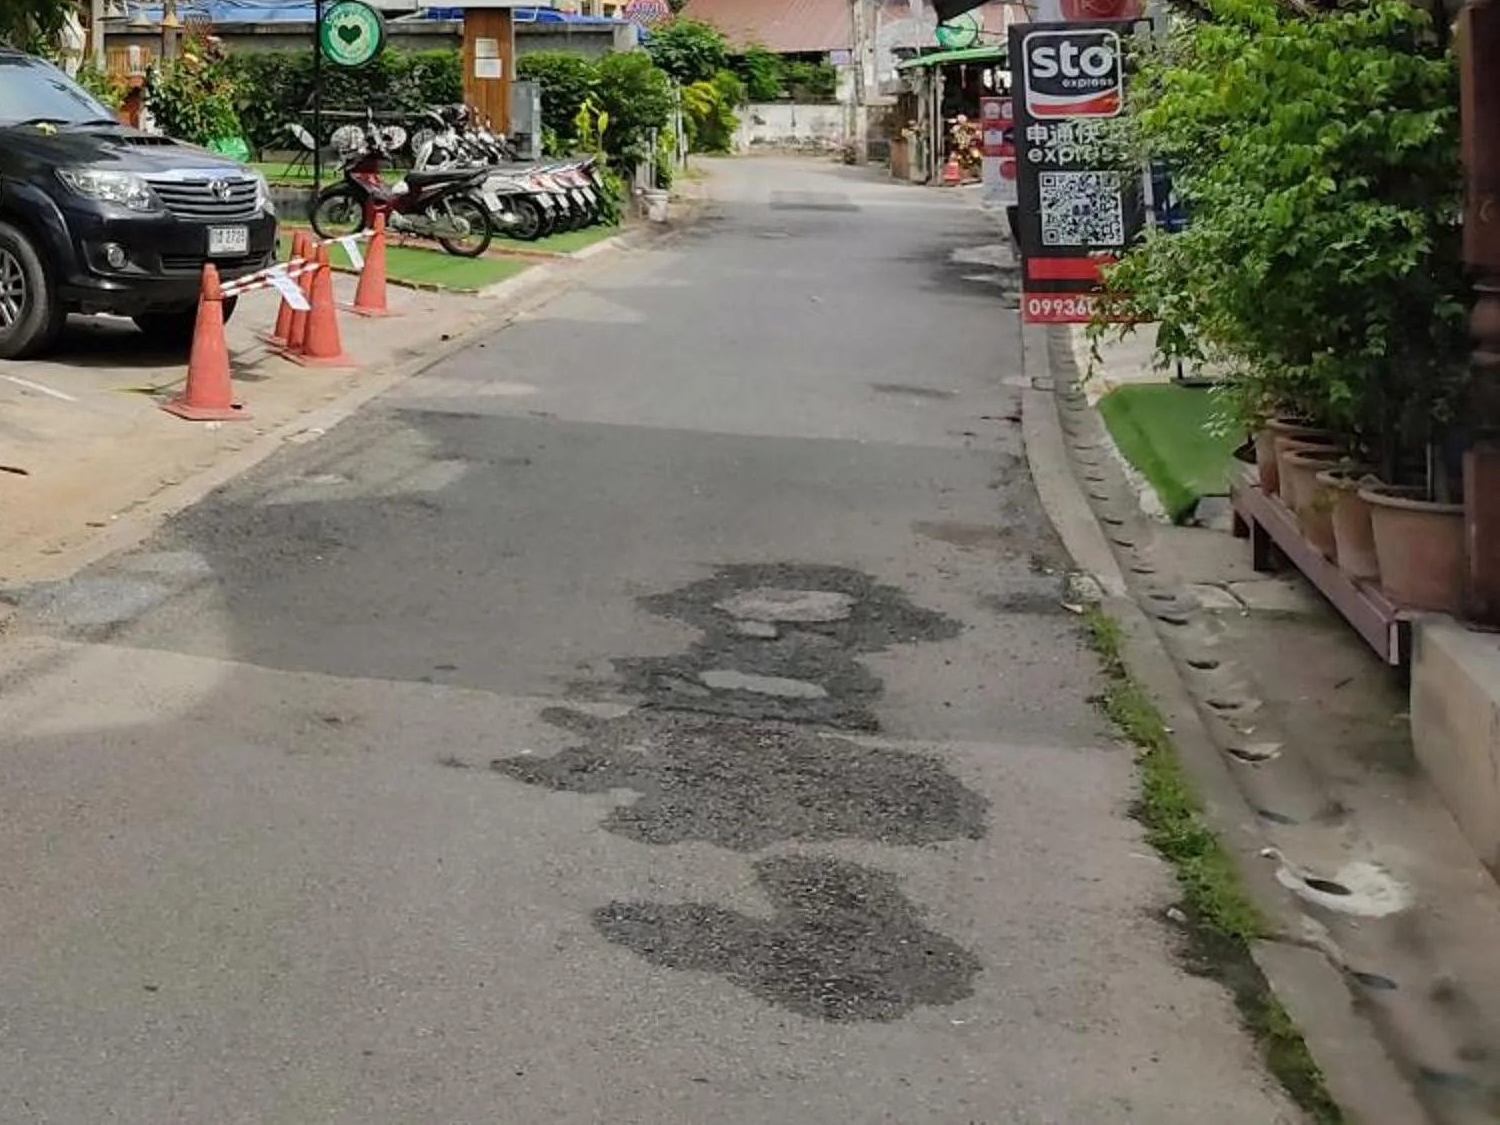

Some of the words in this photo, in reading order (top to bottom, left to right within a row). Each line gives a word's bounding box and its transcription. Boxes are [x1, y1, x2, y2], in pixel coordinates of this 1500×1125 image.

[1031, 40, 1115, 78] sto
[1061, 78, 1114, 89] express
[1026, 122, 1127, 148] 申通快
